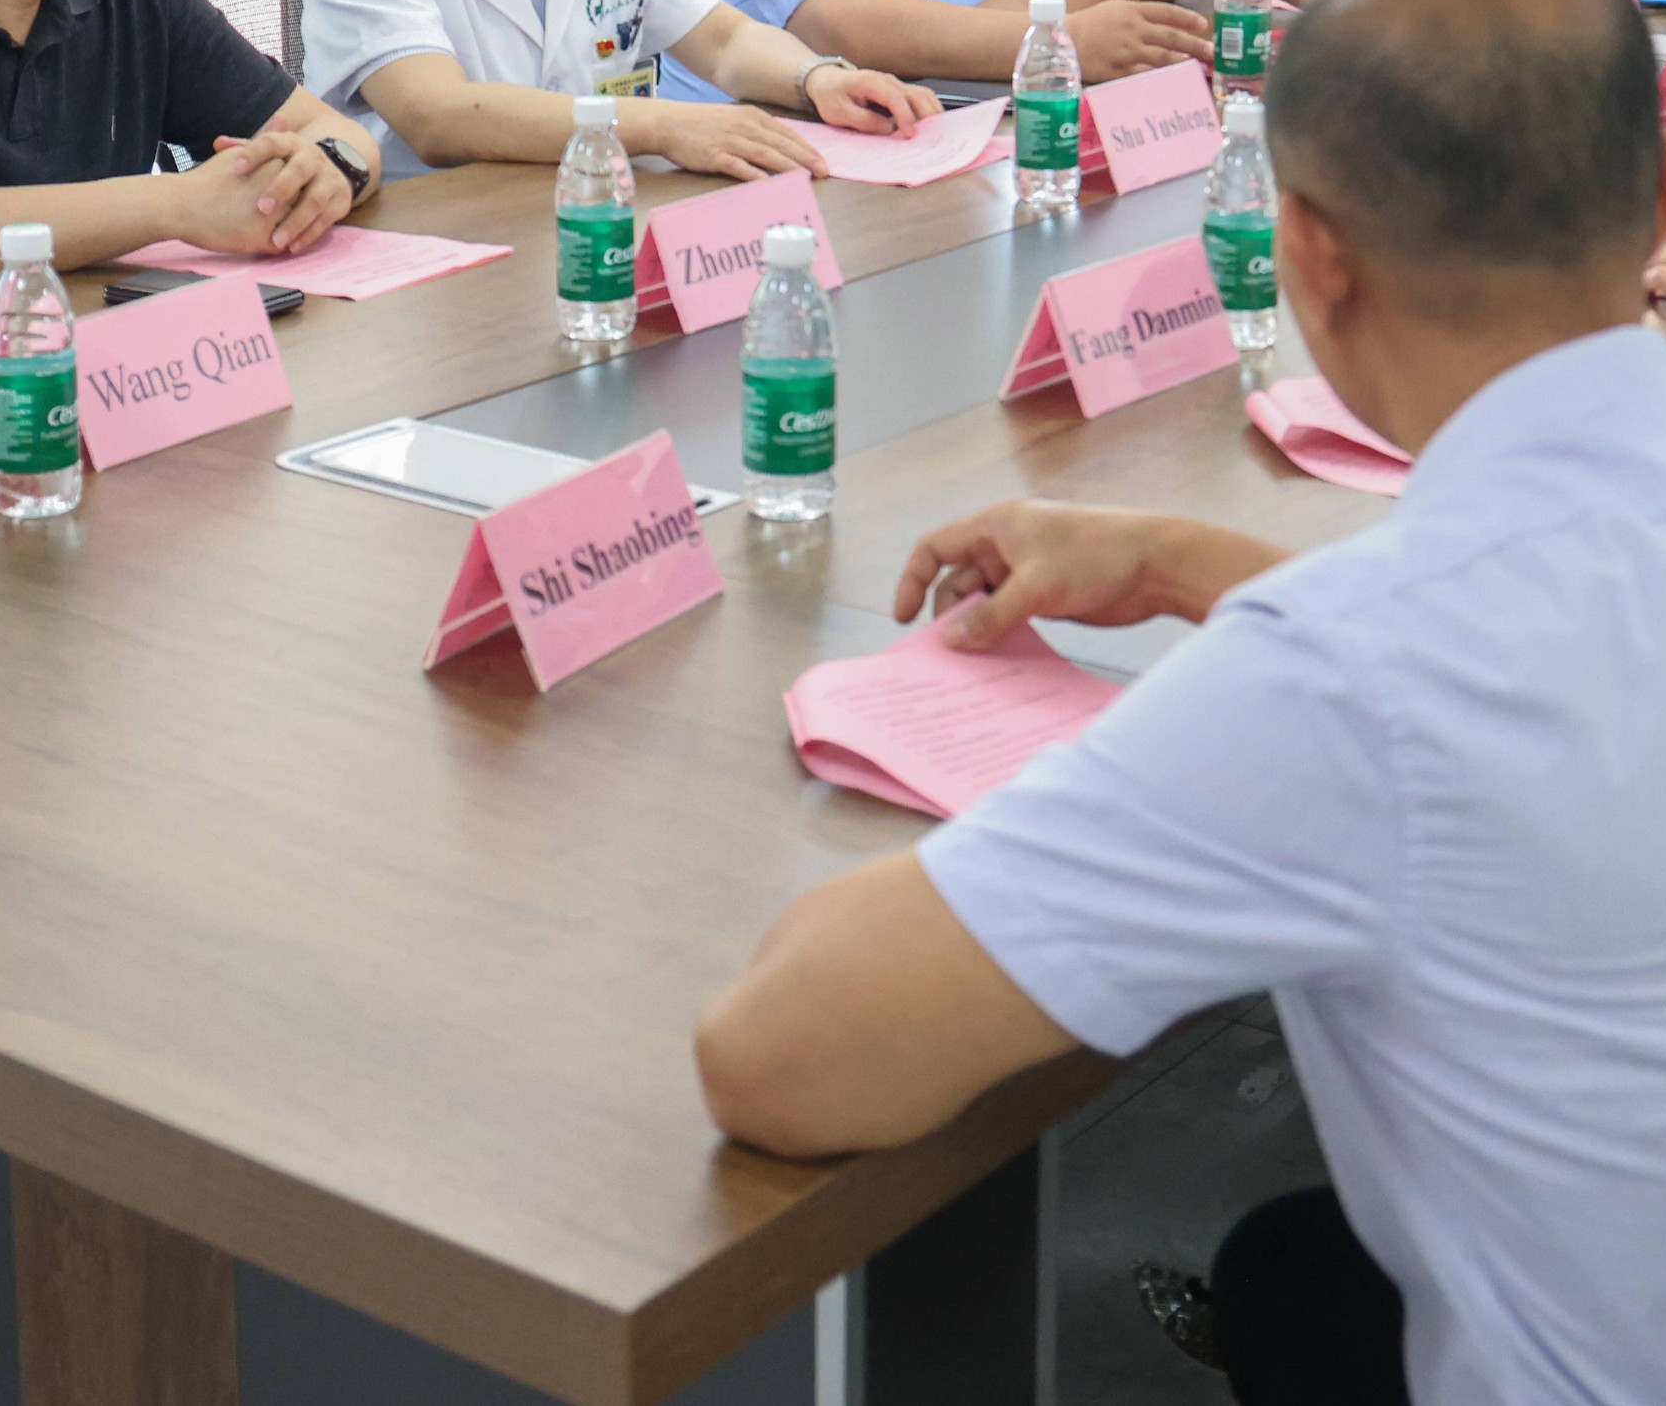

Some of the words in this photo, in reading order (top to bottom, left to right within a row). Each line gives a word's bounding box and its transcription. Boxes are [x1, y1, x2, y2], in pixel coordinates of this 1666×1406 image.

[1110, 124, 1145, 153] Shu
[675, 238, 766, 286] Zhong
[1069, 324, 1138, 364] Fang
[86, 363, 193, 412] Wang
[192, 330, 273, 385] Qian
[519, 557, 575, 617] Shi
[570, 505, 701, 590] Shaobing
